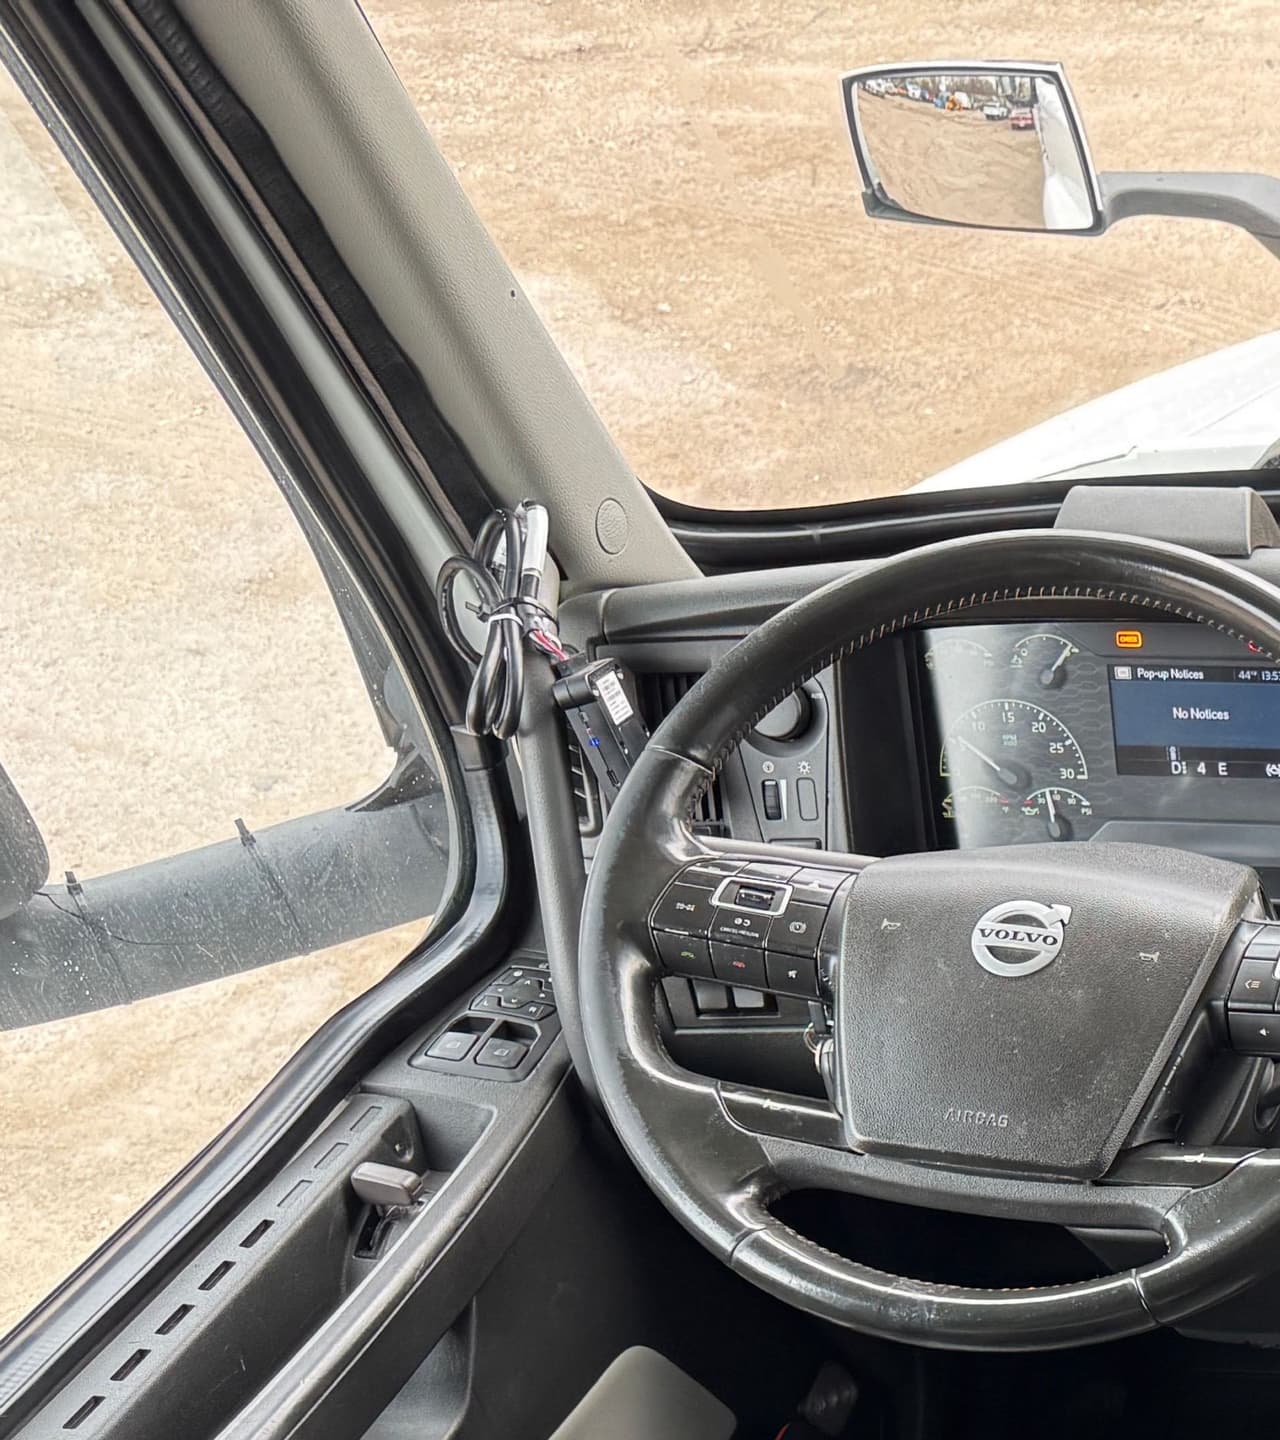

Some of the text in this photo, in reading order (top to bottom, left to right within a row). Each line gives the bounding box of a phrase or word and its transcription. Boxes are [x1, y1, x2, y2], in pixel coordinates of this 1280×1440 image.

[1136, 667, 1170, 681] Pop-up
[1170, 668, 1204, 680] Notices
[1002, 711, 1015, 723] 15
[1172, 707, 1230, 721] No Notices
[1031, 721, 1047, 733] 20
[1049, 741, 1065, 754] 25
[1060, 768, 1075, 780] 30
[1197, 762, 1206, 774] 4
[1218, 762, 1228, 775] E
[977, 927, 1059, 947] VOLVO
[943, 1108, 1010, 1128] AIRBAG
